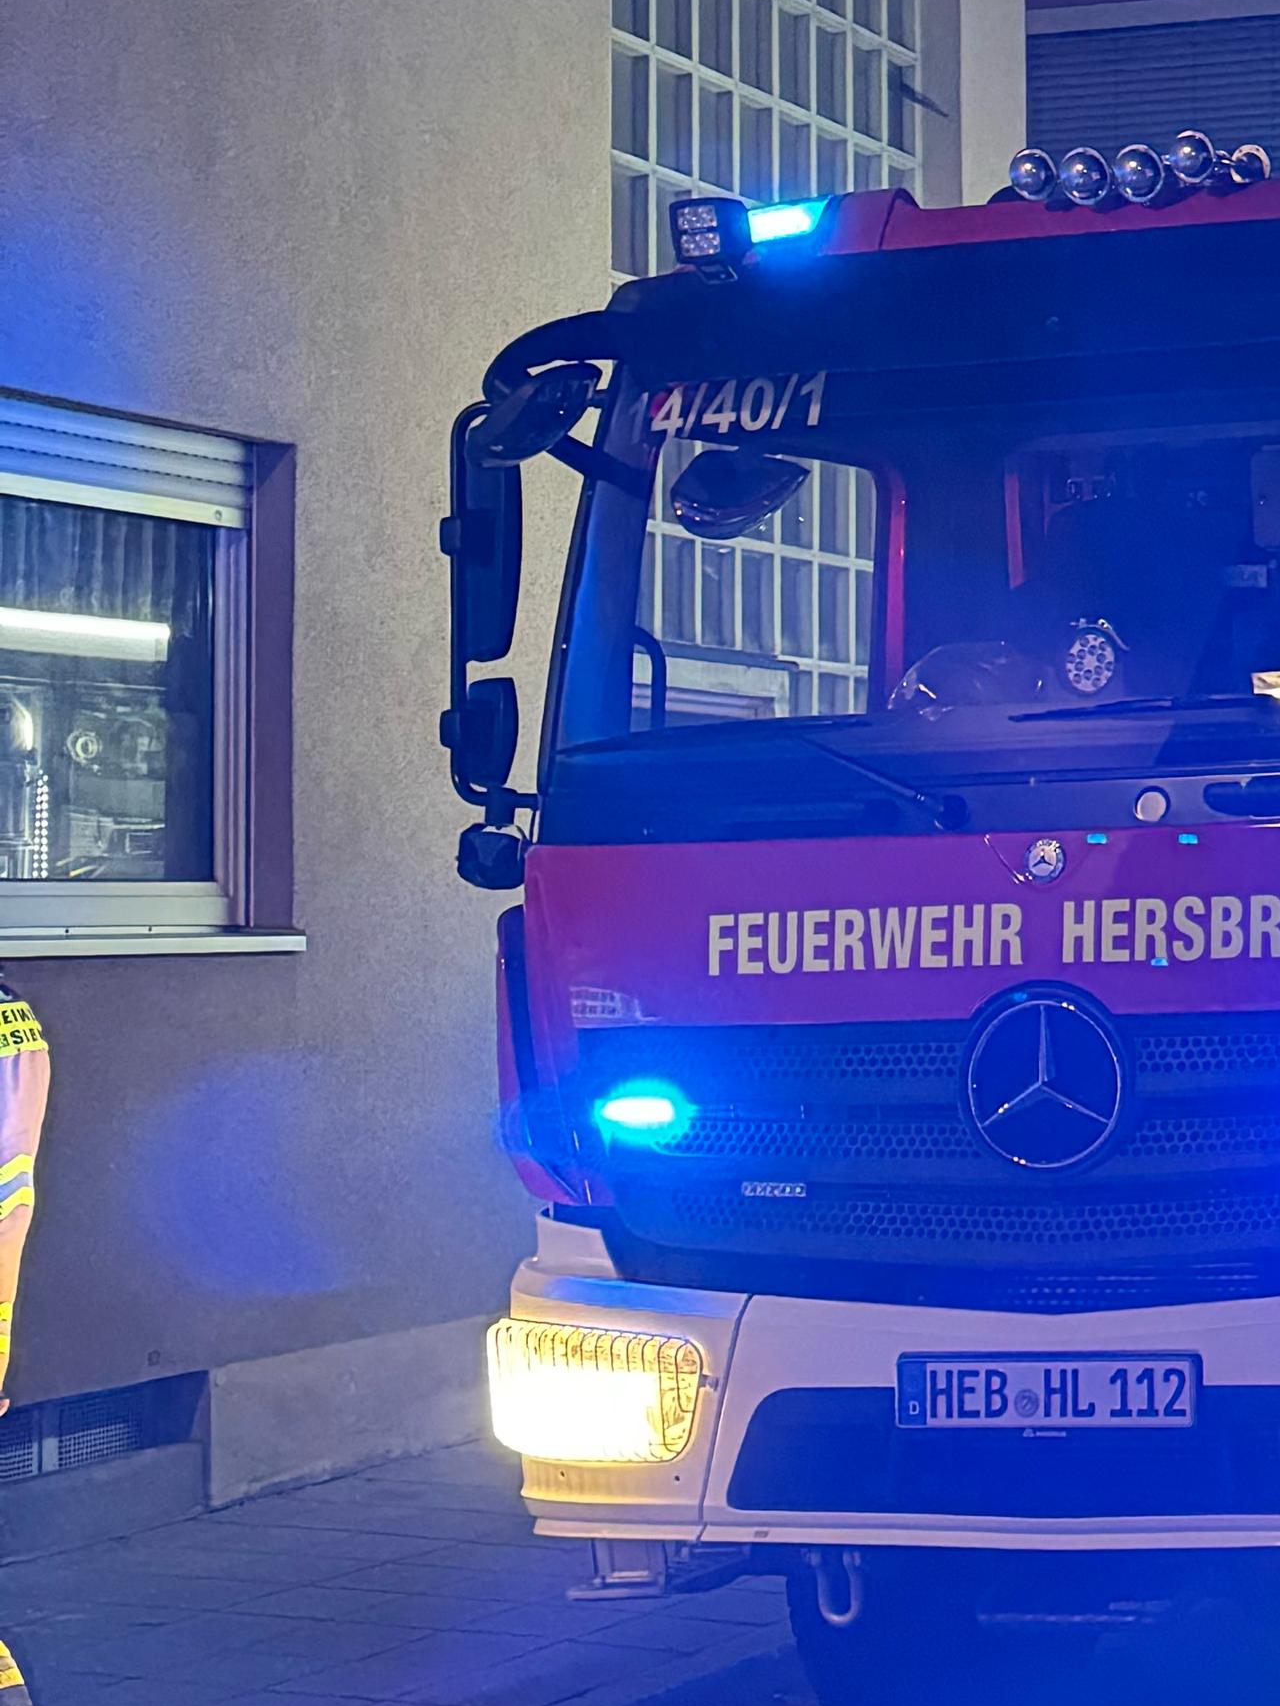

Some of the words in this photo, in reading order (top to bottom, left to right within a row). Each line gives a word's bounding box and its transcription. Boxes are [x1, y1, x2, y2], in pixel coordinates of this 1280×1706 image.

[708, 902, 1024, 975] FEUERWEHR
[909, 1400, 919, 1415] D
[929, 1369, 1008, 1419] HEB
[1043, 1368, 1096, 1418] HL
[1109, 1368, 1187, 1418] 112
